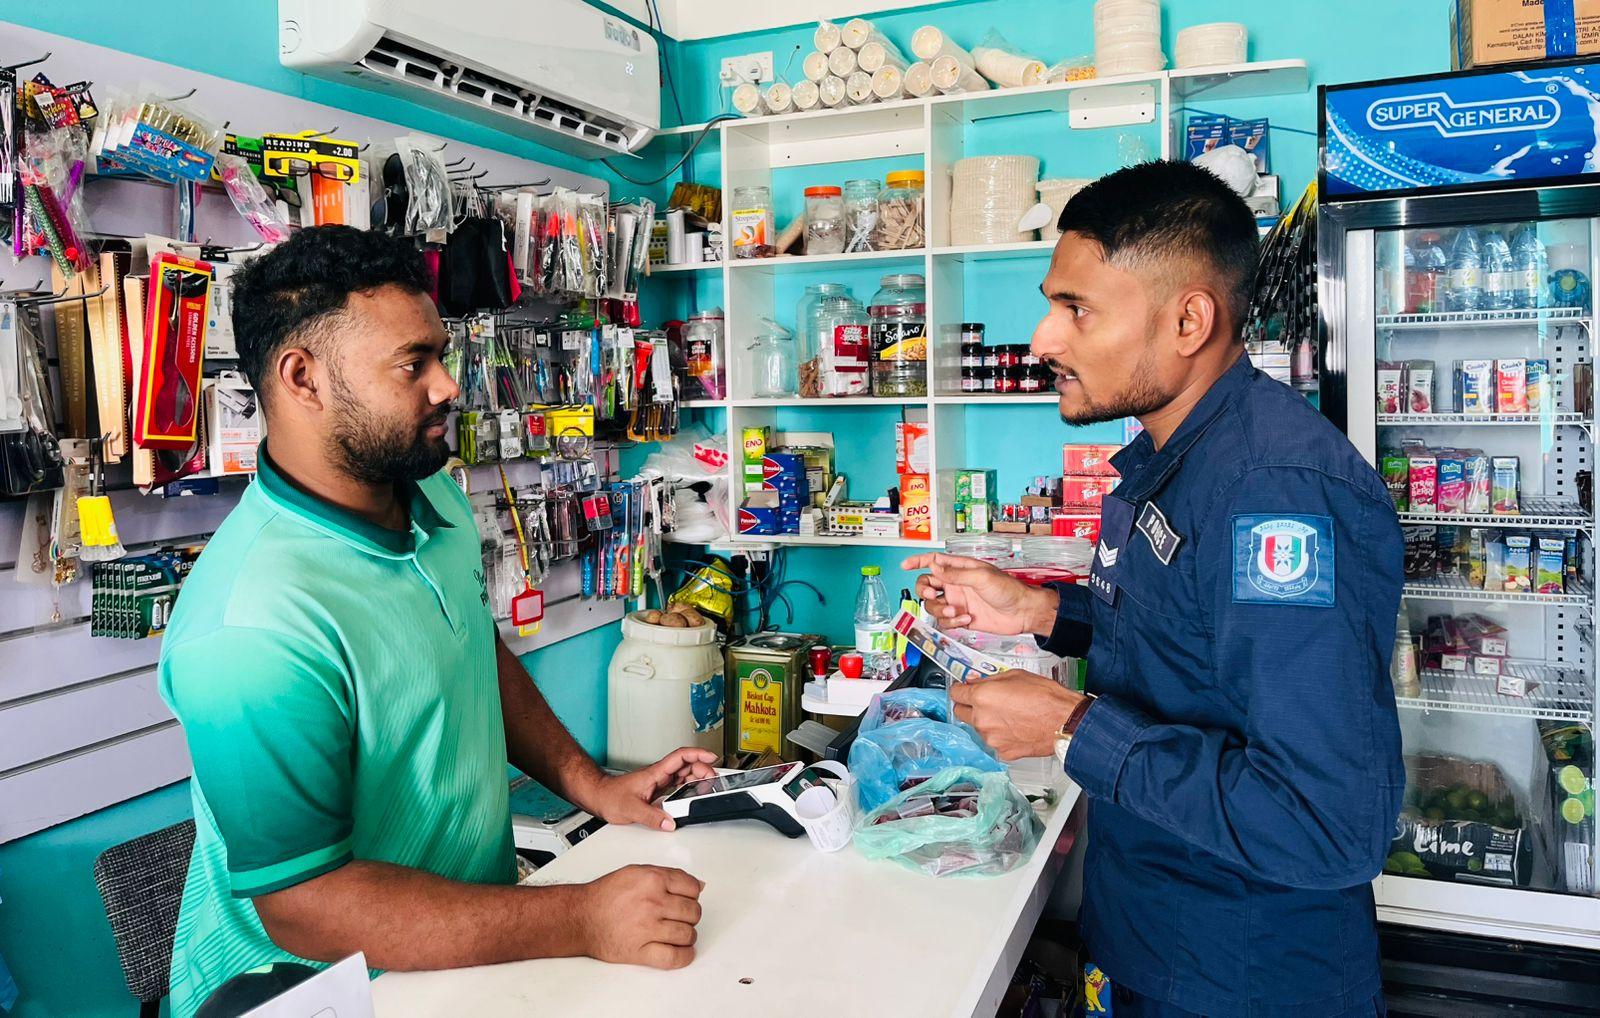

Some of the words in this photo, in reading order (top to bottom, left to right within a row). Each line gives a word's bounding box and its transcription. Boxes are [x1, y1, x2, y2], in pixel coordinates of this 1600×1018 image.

[1375, 102, 1441, 122] SUPER
[1450, 104, 1551, 128] GENERAL
[266, 139, 310, 148] READING
[885, 326, 920, 343] Soano
[189, 336, 197, 363] SCISSORS
[745, 439, 762, 448] ENO
[911, 482, 924, 490] ENO
[906, 505, 929, 516] ENO
[744, 701, 777, 716] Mahkota
